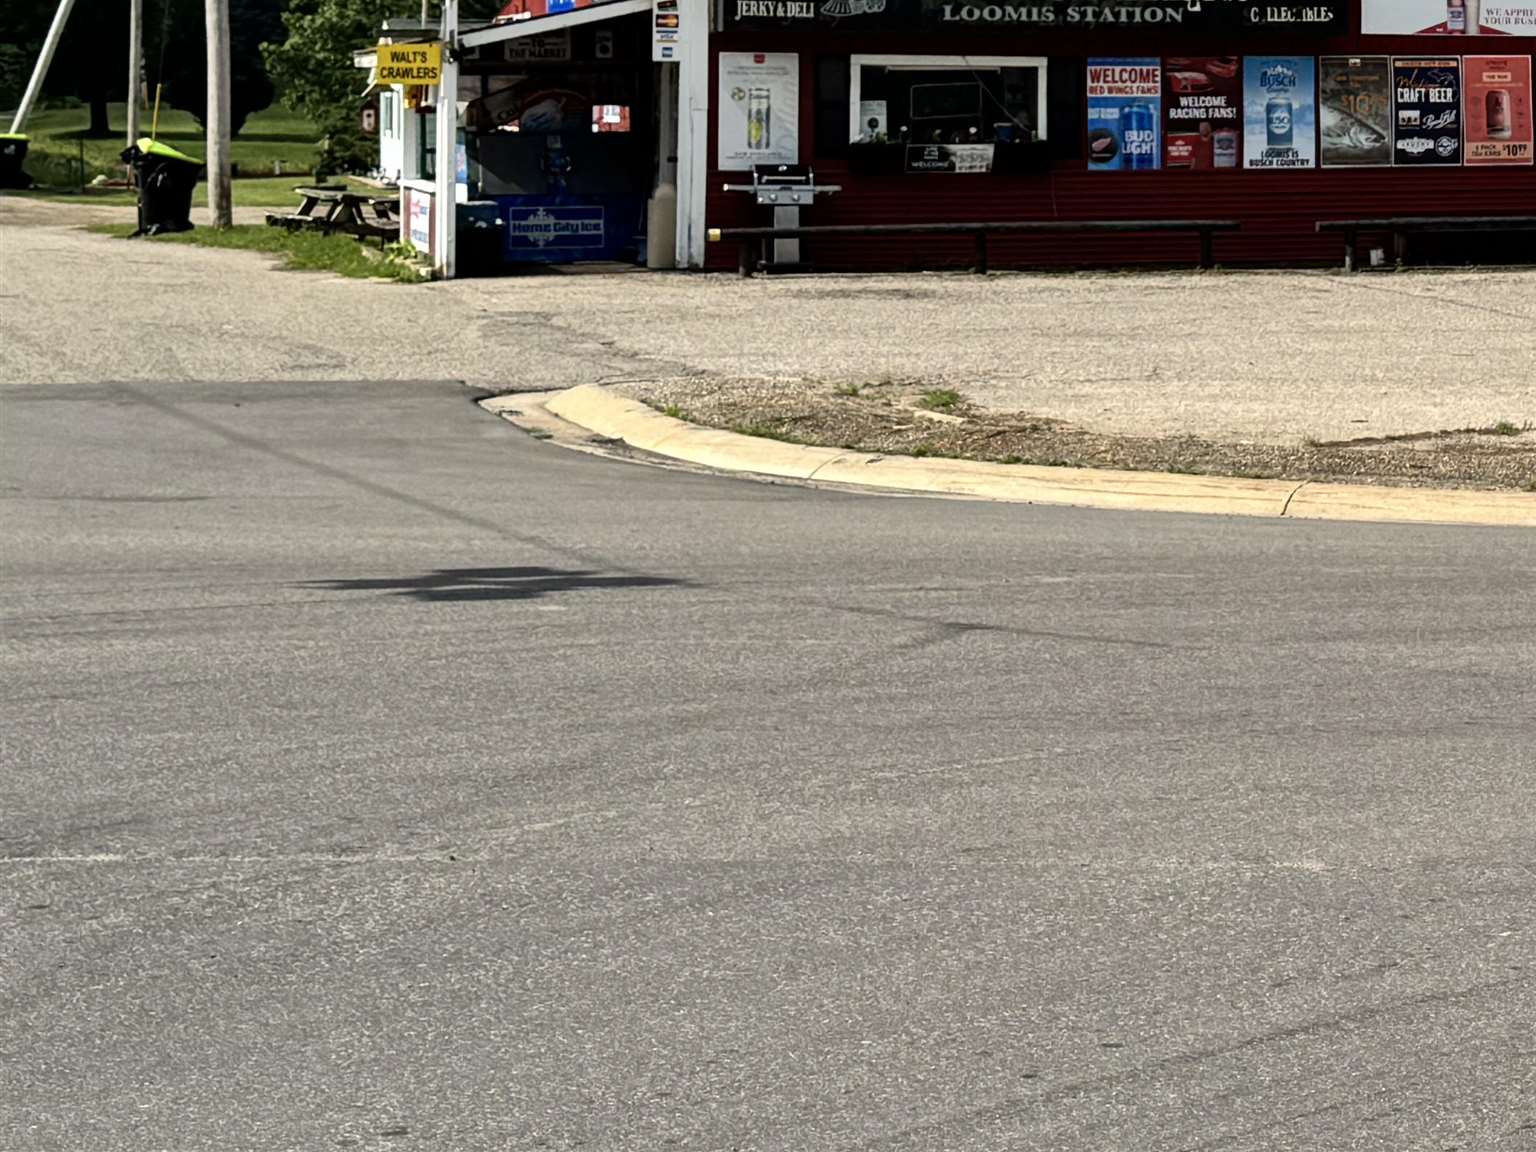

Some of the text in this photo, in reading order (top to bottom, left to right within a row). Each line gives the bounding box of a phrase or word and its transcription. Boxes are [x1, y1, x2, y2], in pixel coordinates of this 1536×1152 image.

[942, 5, 1185, 23] LOOMIS STATION
[1486, 8, 1502, 16] WE
[1484, 17, 1511, 25] YOUR
[390, 51, 428, 63] WALT'S
[380, 67, 438, 79] CRAWLERS
[1089, 68, 1159, 84] WELCOME
[1260, 70, 1296, 87] BUSCH
[1089, 85, 1105, 95] RED
[1107, 85, 1134, 95] WINGS
[1397, 87, 1453, 103] CRAFT BEER
[1179, 95, 1227, 107] WELCOME
[1169, 107, 1237, 119] RACING FANS!
[1124, 130, 1153, 142] BUD
[1249, 158, 1310, 167] BUSCH COUNTRY
[513, 222, 601, 234] Home City Ice
